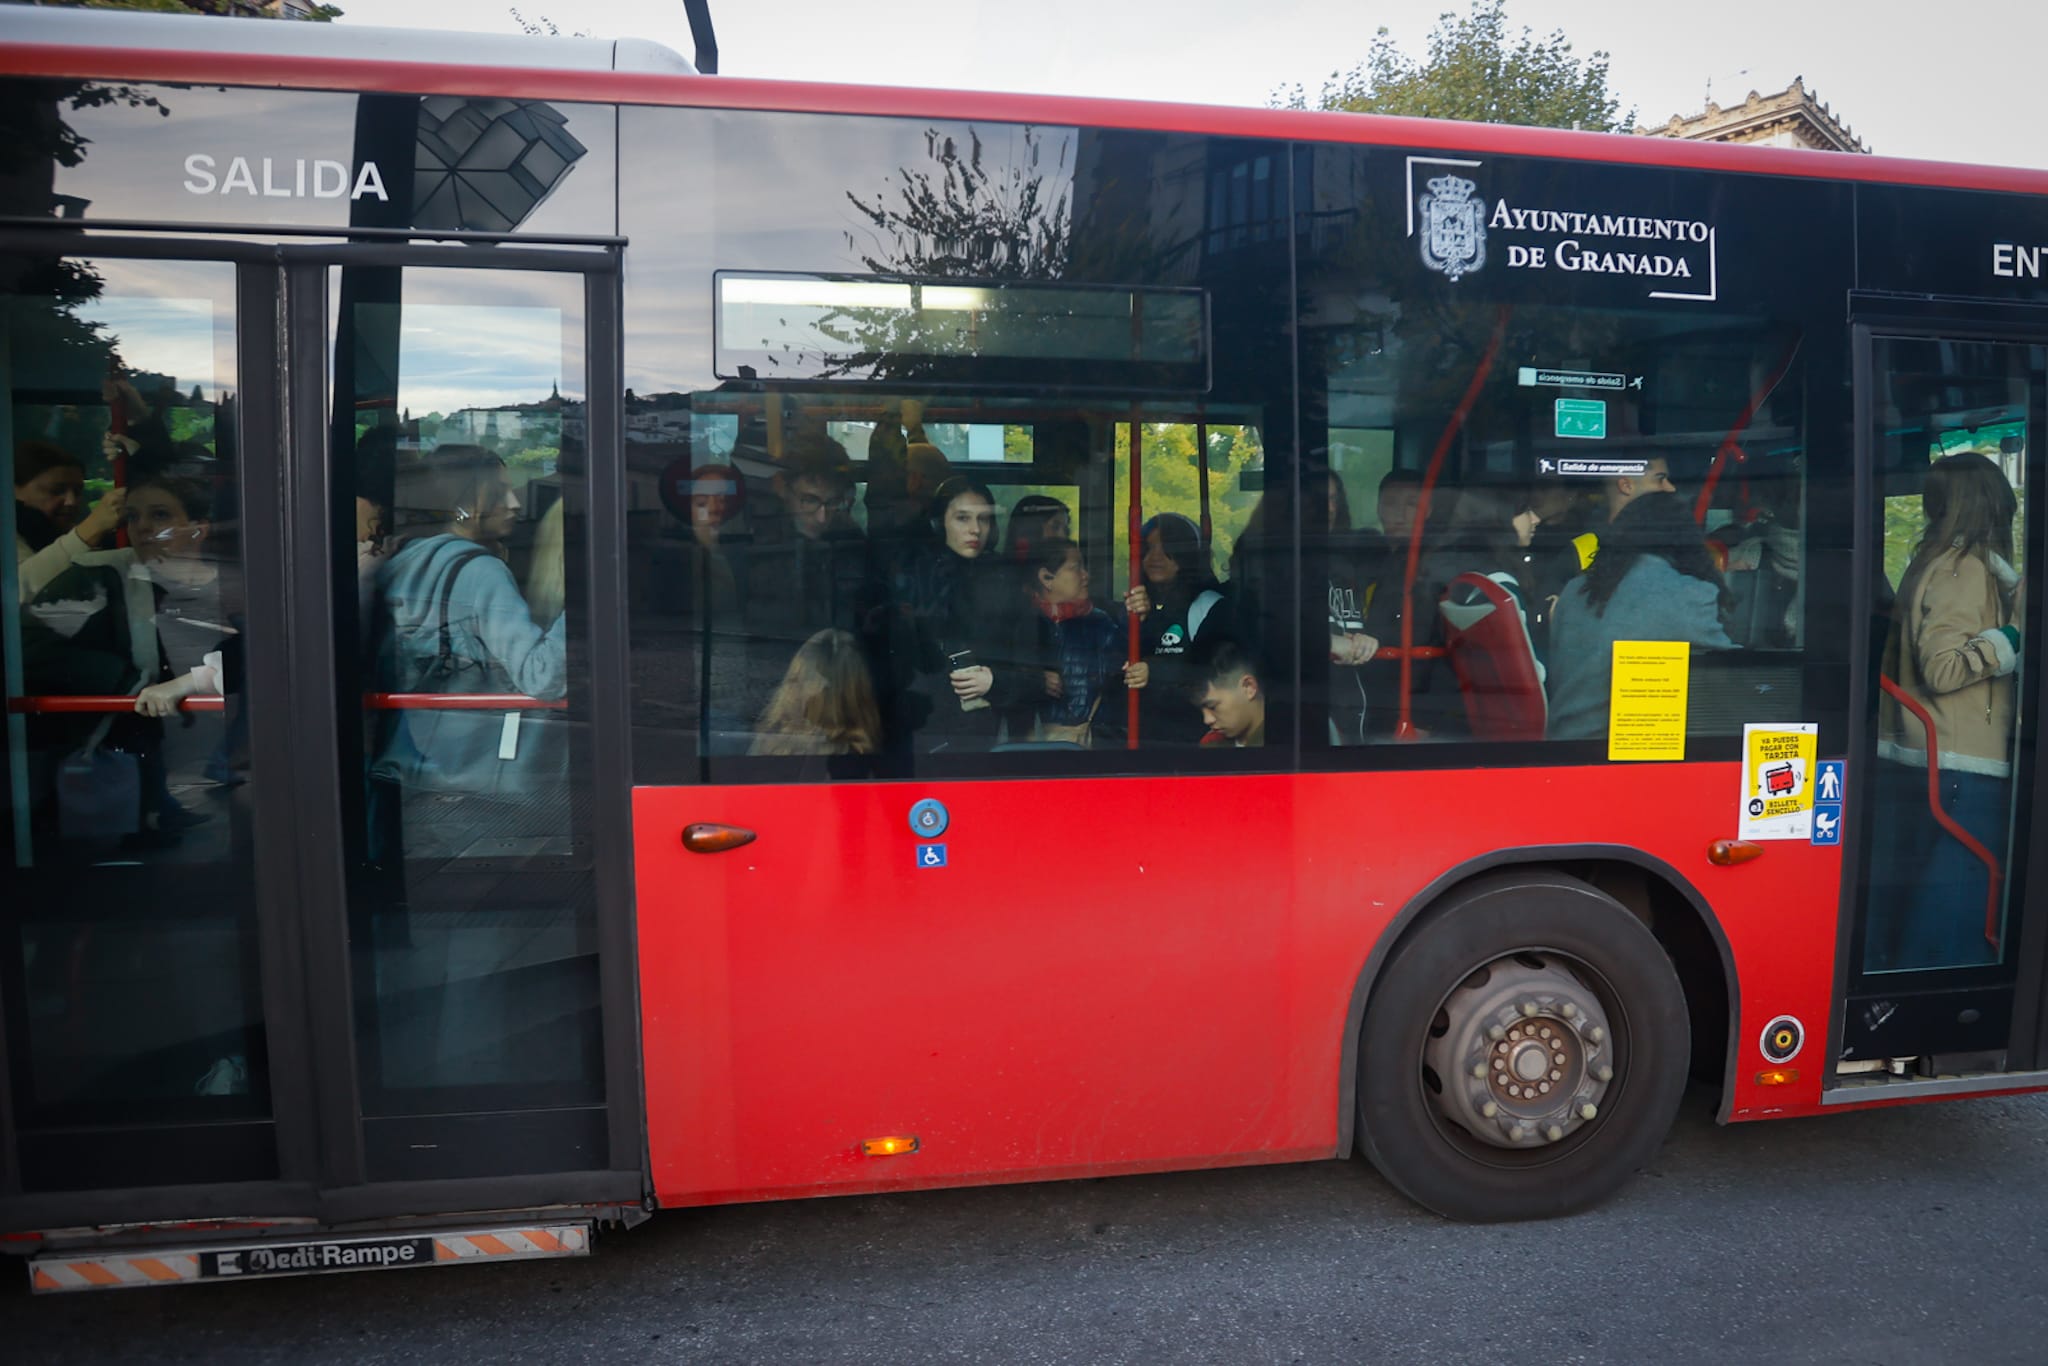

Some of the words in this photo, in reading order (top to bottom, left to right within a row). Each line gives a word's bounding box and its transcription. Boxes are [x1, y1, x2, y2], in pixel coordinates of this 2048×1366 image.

[184, 154, 389, 201] SALIDA
[1489, 198, 1708, 242] AYUNTAMIENTO
[1508, 245, 1546, 268] DE
[1555, 240, 1691, 277] GRANADA
[1773, 735, 1799, 743] PUEDES
[1764, 751, 1799, 760] TARJETA
[1769, 799, 1798, 807] BILLETE
[1766, 807, 1801, 815] SENCILLO
